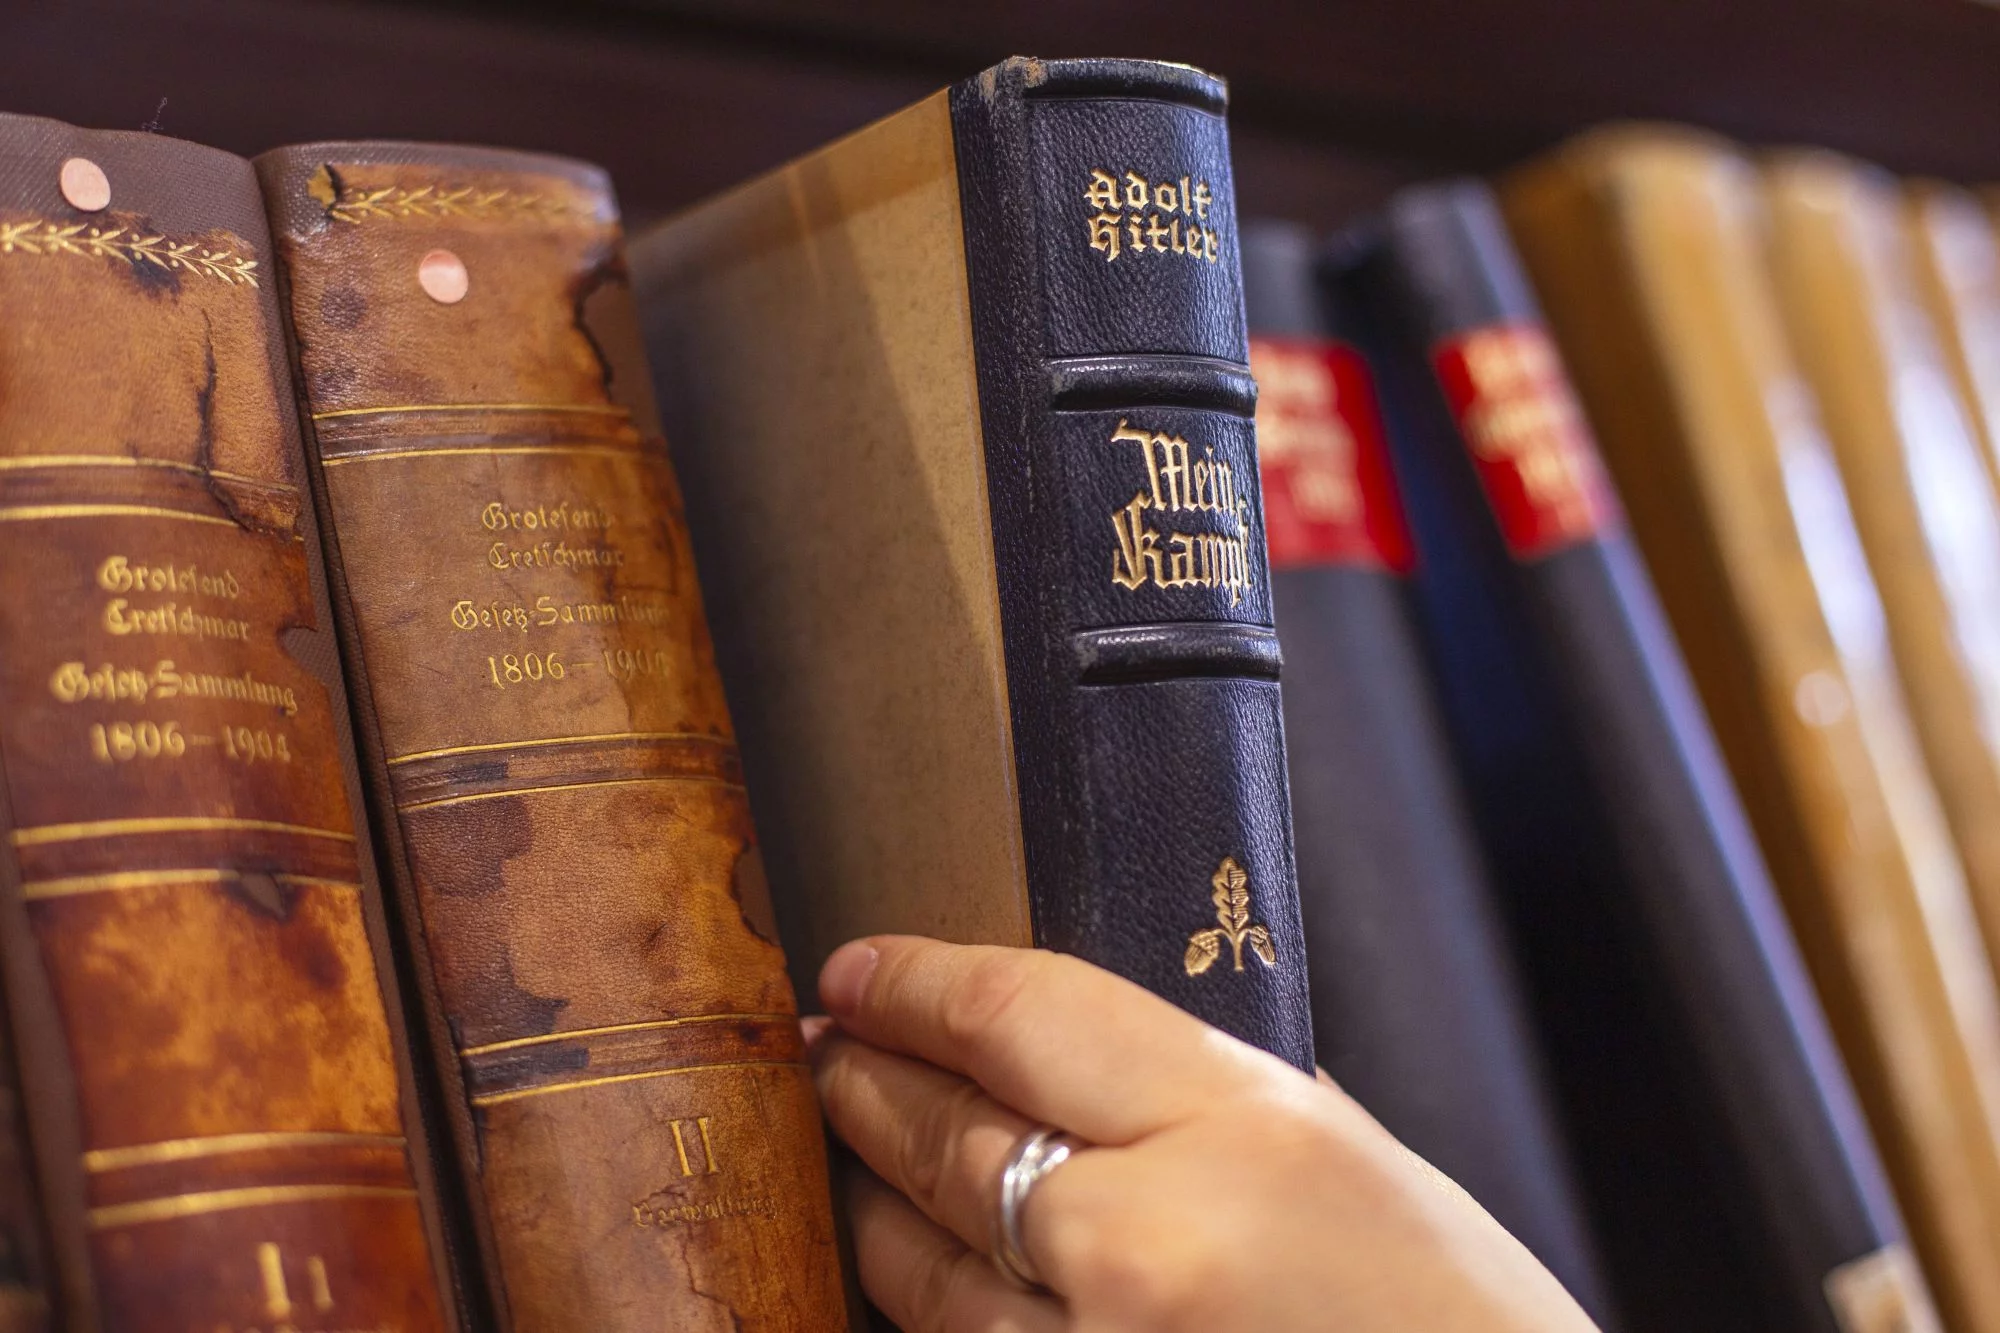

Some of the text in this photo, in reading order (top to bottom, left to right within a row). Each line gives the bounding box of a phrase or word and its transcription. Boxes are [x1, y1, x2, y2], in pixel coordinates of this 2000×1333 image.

[1083, 167, 1213, 220] Adolf
[1087, 211, 1219, 264] Hitler
[1111, 417, 1237, 514] Mein
[1111, 489, 1252, 608] Kampf
[670, 1115, 718, 1177] II
